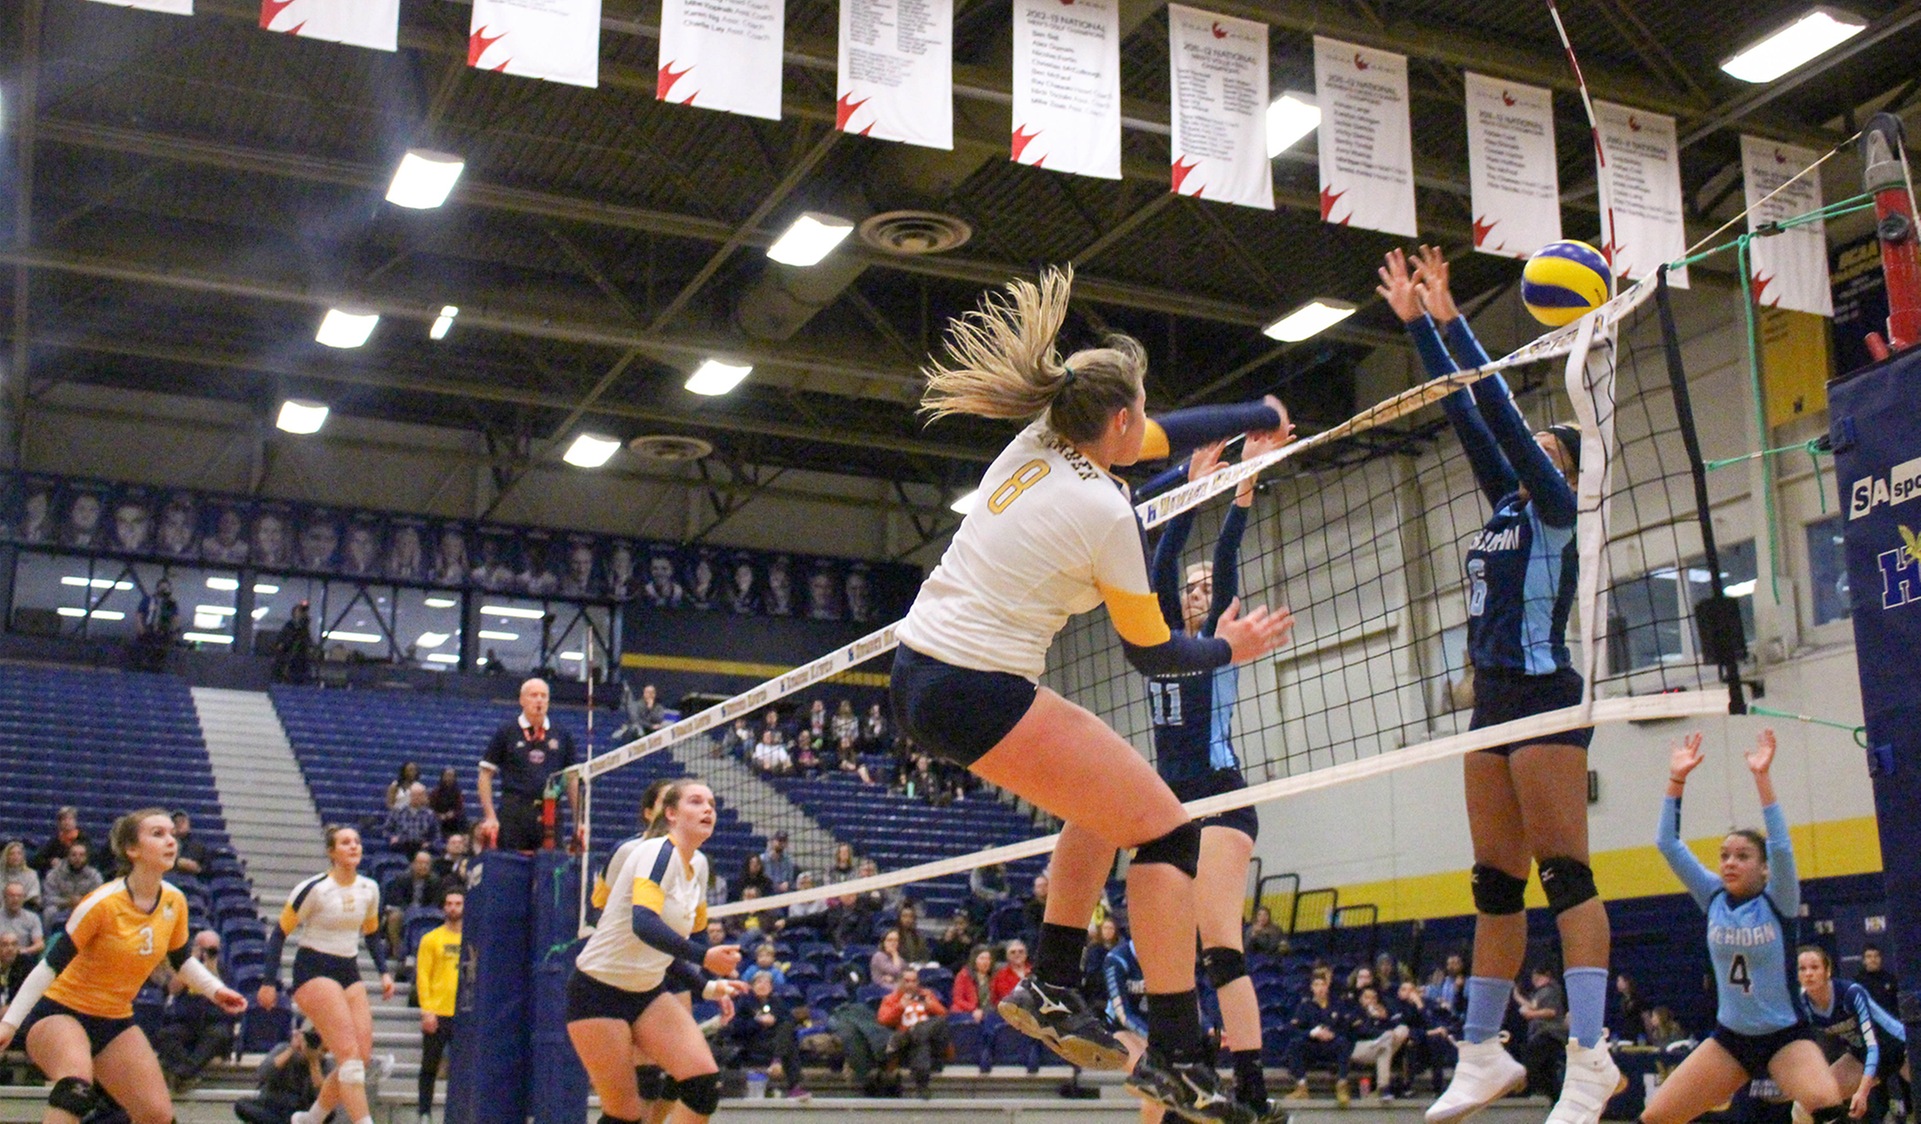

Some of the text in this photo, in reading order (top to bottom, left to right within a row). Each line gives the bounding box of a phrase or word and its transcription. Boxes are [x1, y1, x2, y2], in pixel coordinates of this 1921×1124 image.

[987, 457, 1052, 515] 8
[1468, 558, 1488, 616] 6
[1150, 682, 1183, 726] 11
[139, 926, 154, 956] 3
[1727, 953, 1753, 996] 4
